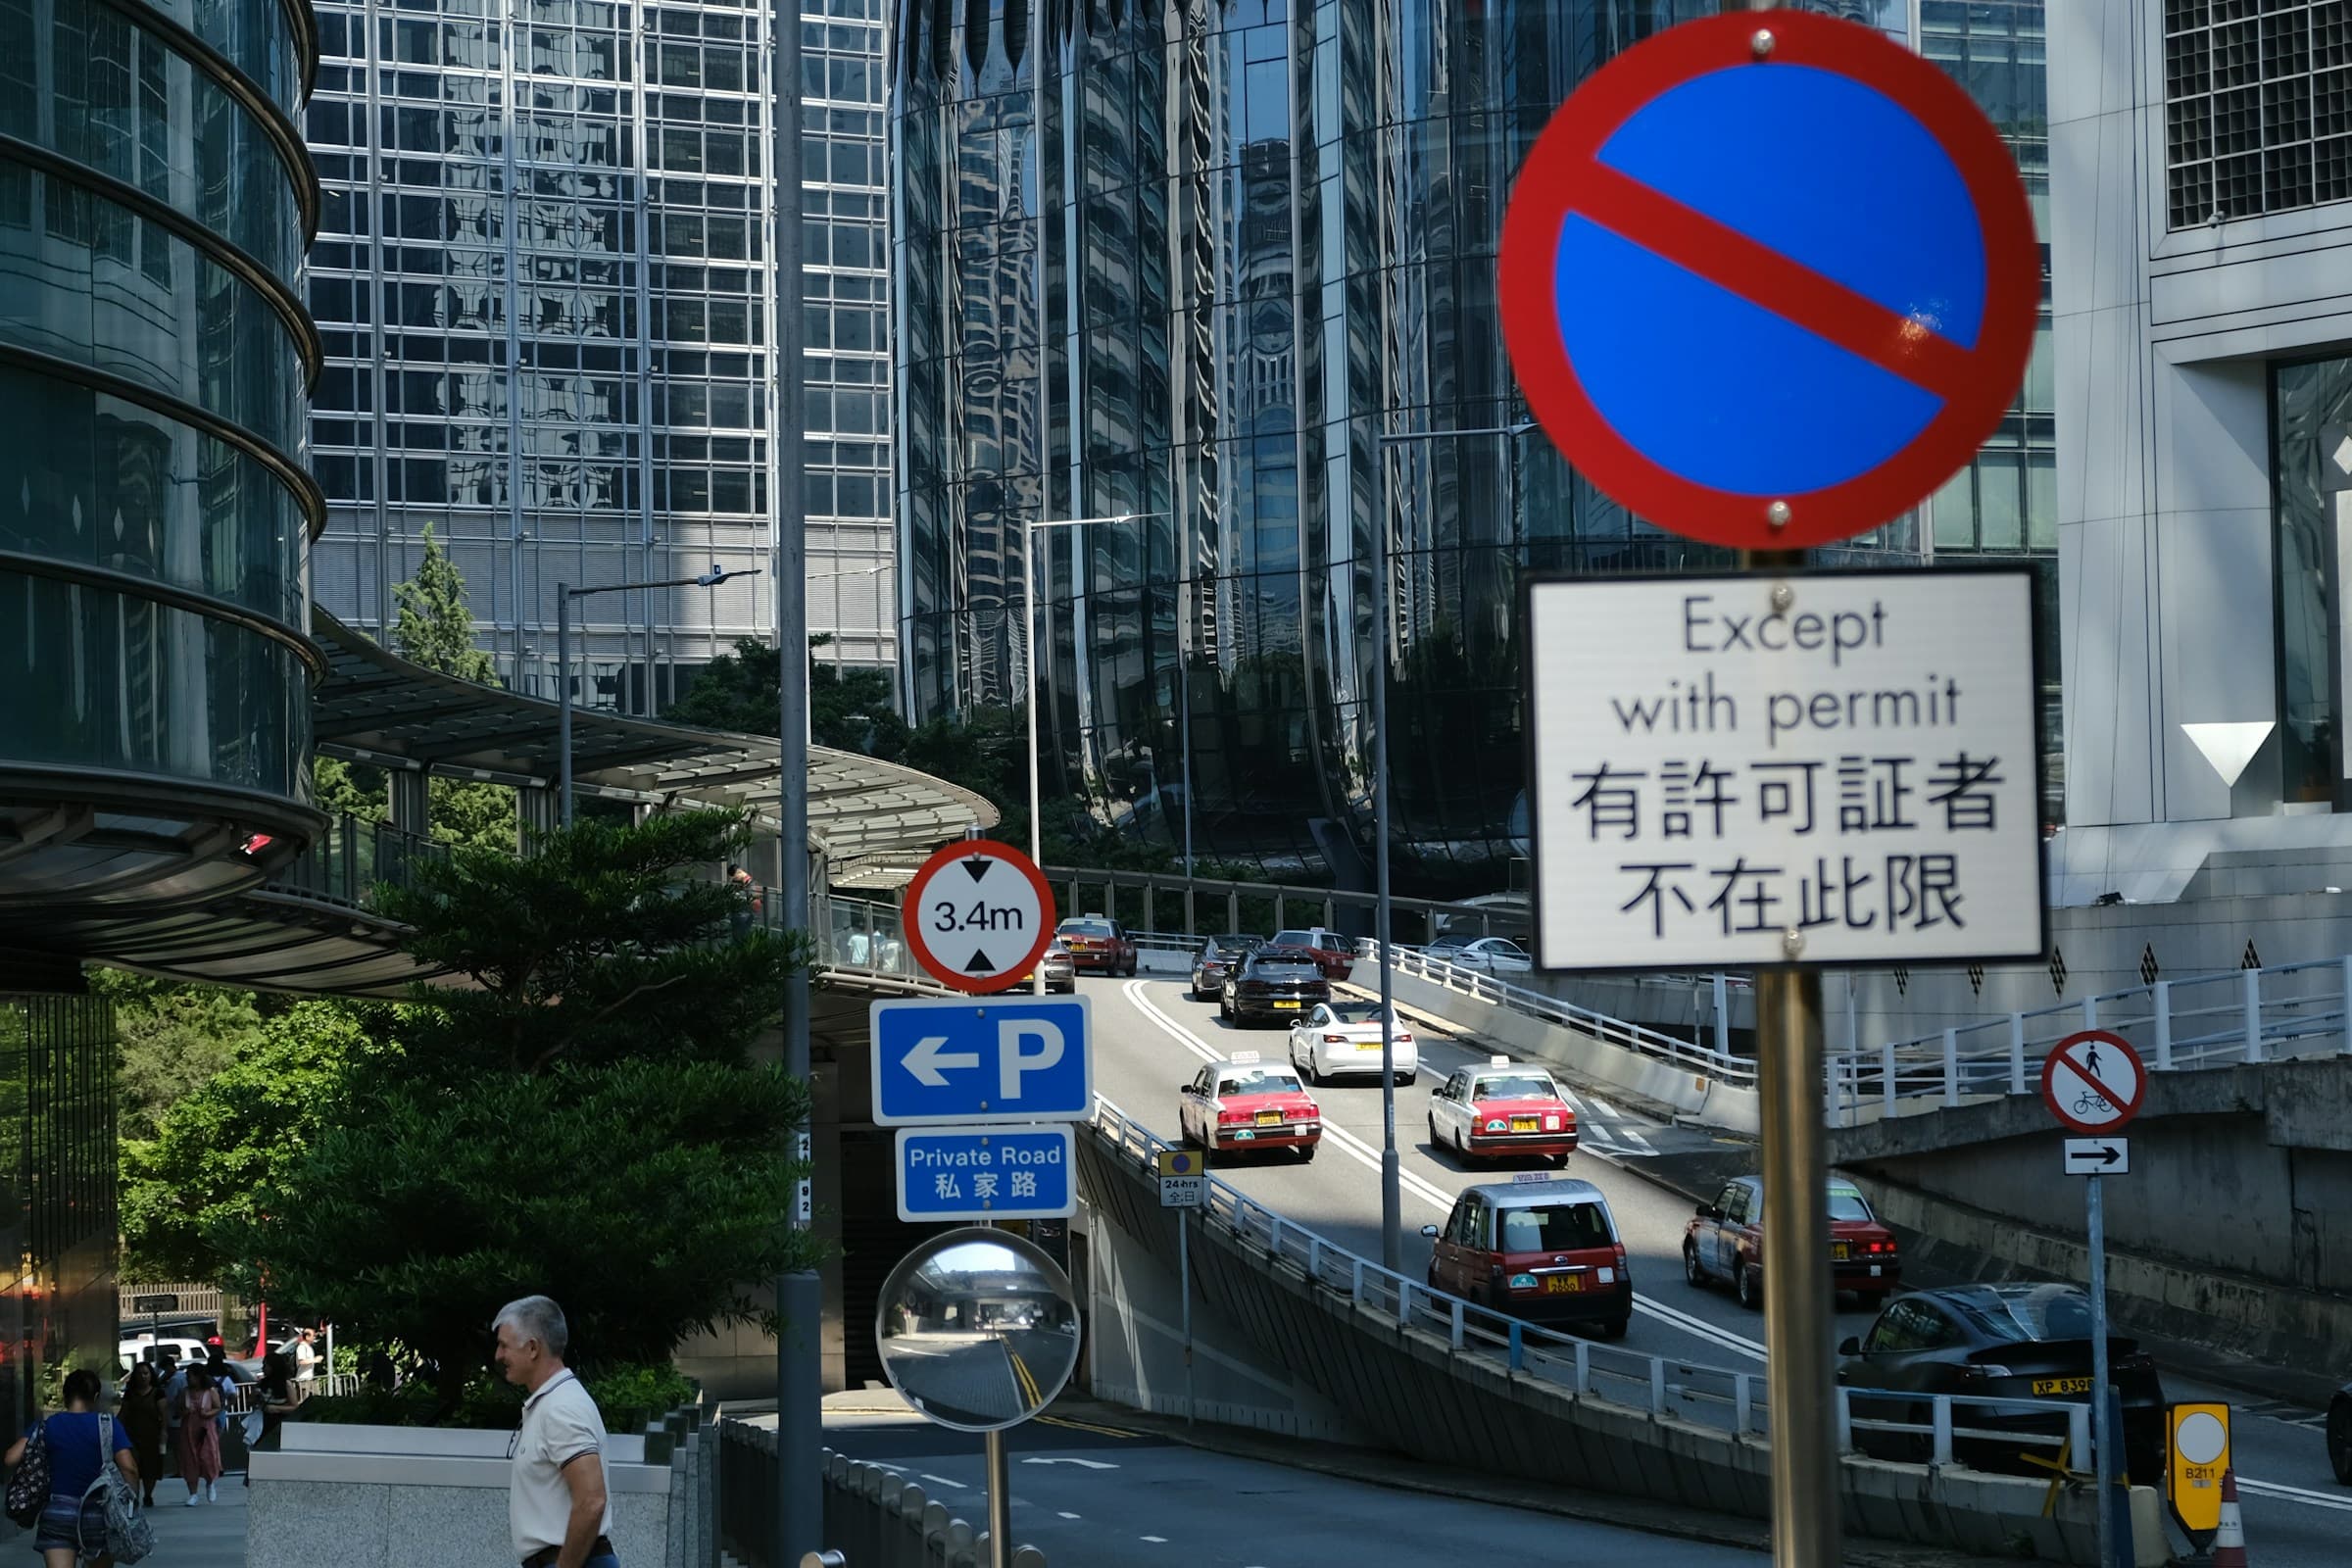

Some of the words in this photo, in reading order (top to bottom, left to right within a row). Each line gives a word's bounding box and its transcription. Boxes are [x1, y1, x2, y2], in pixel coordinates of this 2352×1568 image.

[1682, 595, 1887, 666] Except
[1610, 670, 1738, 734] with
[1768, 673, 1962, 749] permit
[1570, 751, 2006, 843] 有許可証者
[1618, 853, 1968, 940] 不在此限
[934, 901, 1022, 932] 3.4m
[998, 1019, 1065, 1100] P
[910, 1148, 992, 1168] Private
[1002, 1145, 1061, 1165] Road
[935, 1171, 1037, 1200] 私家路
[1169, 1191, 1195, 1203] 全日
[2037, 1382, 2054, 1394] XP
[2185, 1467, 2215, 1479] B211
